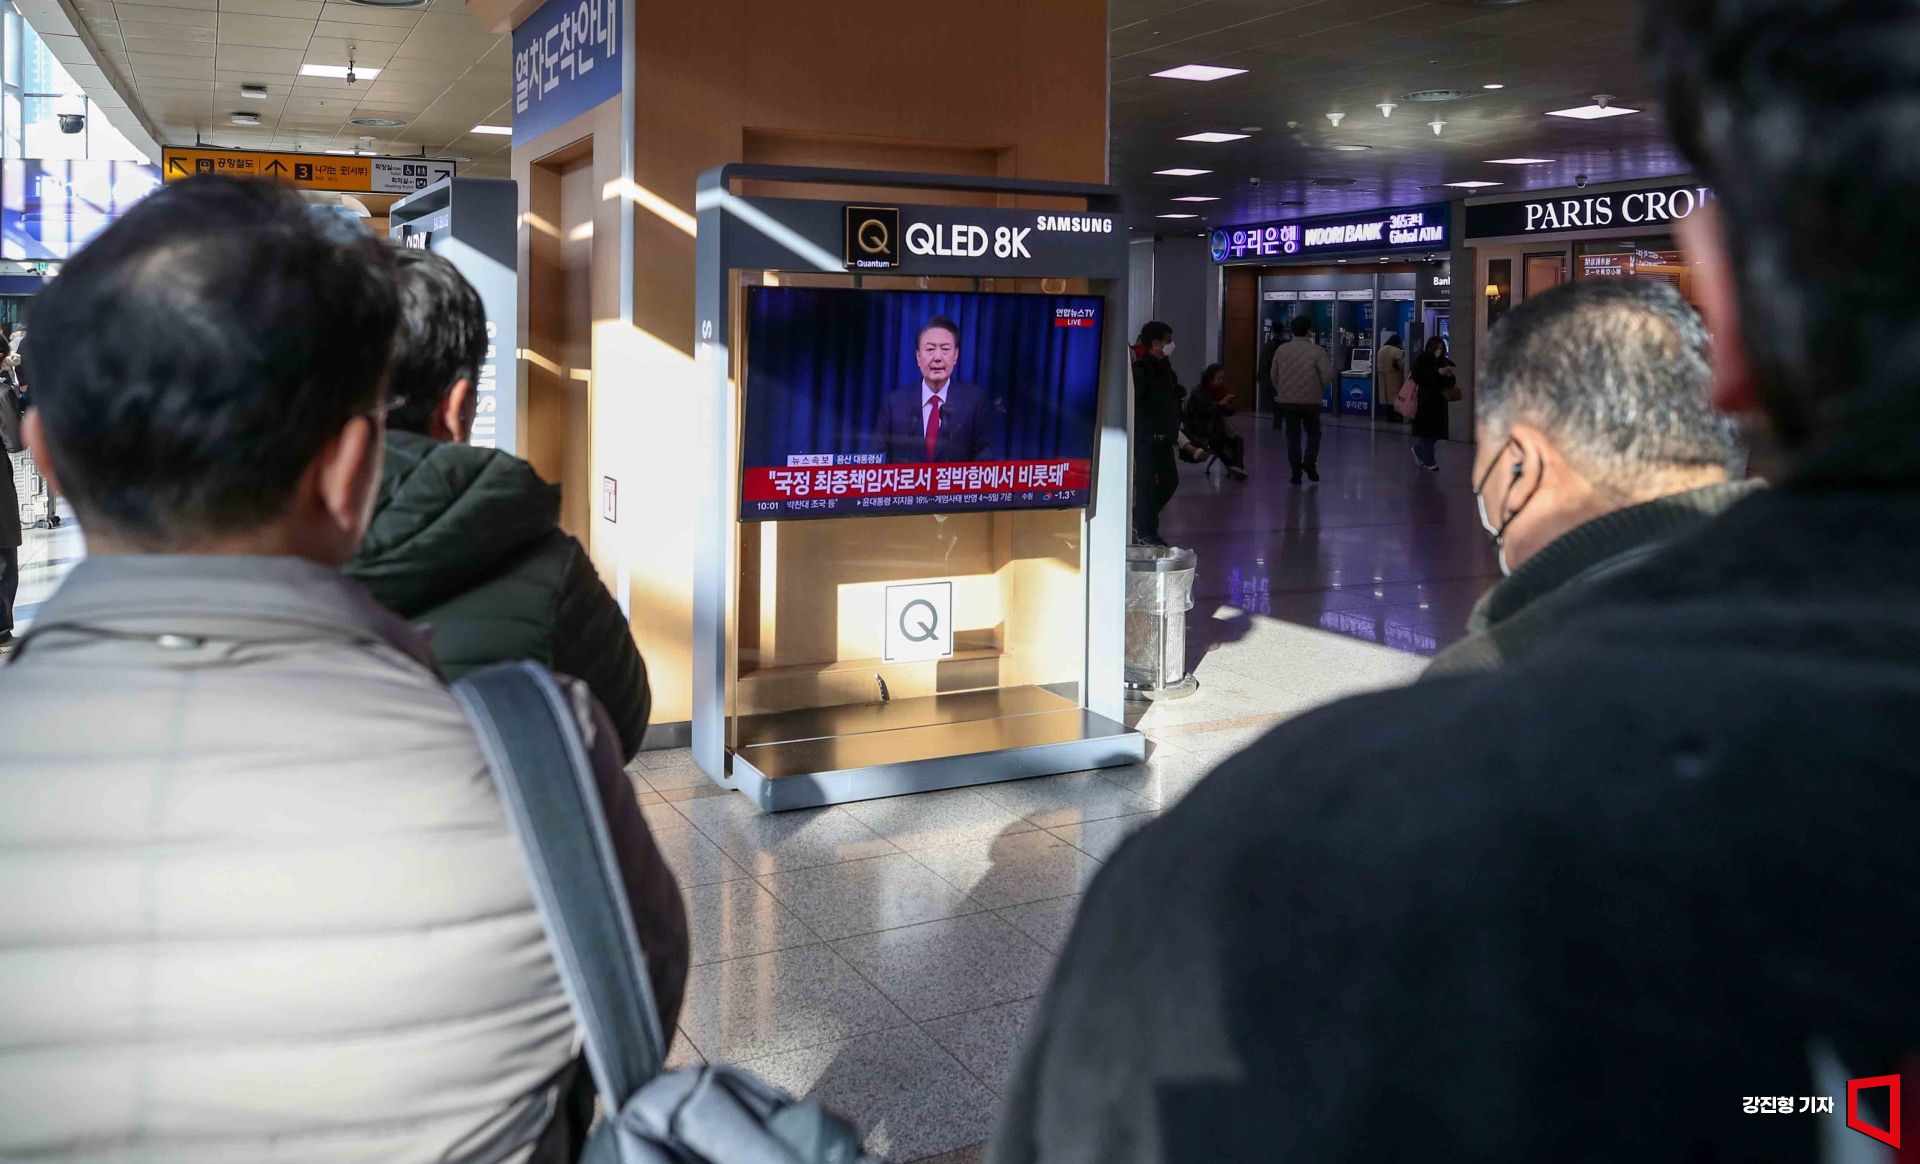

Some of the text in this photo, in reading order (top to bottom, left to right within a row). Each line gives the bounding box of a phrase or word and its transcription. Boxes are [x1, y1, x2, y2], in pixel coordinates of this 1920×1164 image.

[516, 0, 616, 115] 열차도착안내
[217, 157, 254, 168] 공항철도
[315, 165, 367, 176] 나가는 곳(서부)
[300, 165, 308, 178] 3
[1524, 187, 1716, 231] PARIS CROI
[1036, 215, 1113, 233] SAMSUNG
[858, 219, 892, 254] Q
[905, 222, 1032, 259] QLED 8K
[1231, 225, 1301, 257] 우리은행
[1305, 221, 1386, 247] WOORI BANK
[1419, 225, 1443, 242] ATM
[856, 259, 890, 268] Quantum
[1055, 308, 1095, 318] 연합뉴스TV
[791, 454, 883, 465] 뉴스속보 용산 대통령실
[768, 463, 1070, 496] "국정 최종책임자로서 절박함에서 비롯돼"
[757, 502, 779, 510] 10:01
[811, 499, 826, 509] 조국
[862, 497, 891, 507] 윤대통령
[892, 495, 914, 505] 지지율
[963, 493, 978, 503] 반영
[978, 492, 999, 502] 4~5일
[899, 598, 940, 643] Q
